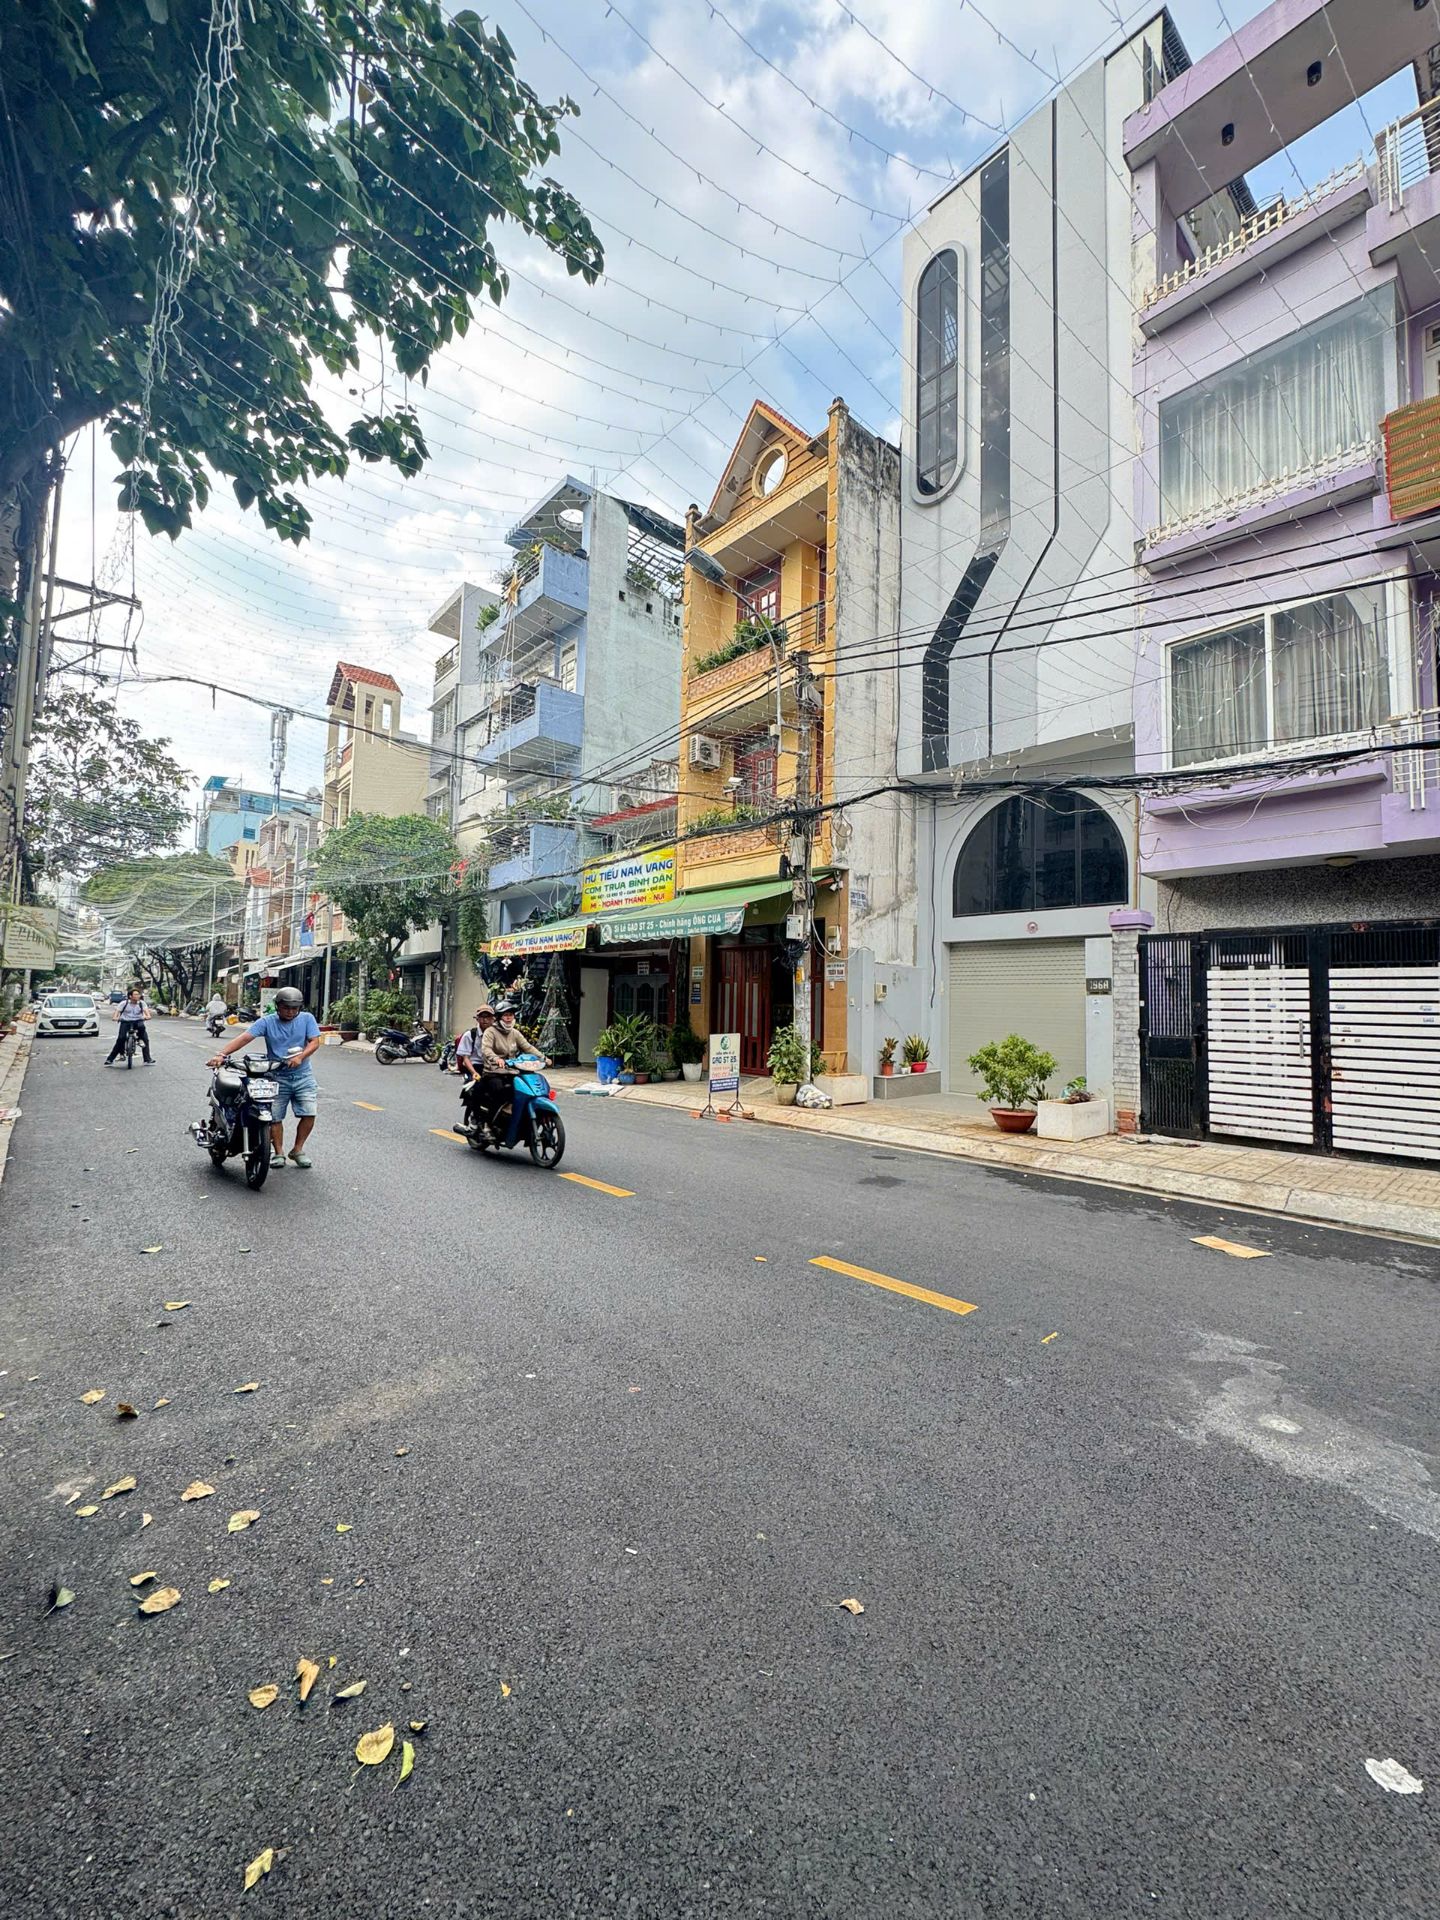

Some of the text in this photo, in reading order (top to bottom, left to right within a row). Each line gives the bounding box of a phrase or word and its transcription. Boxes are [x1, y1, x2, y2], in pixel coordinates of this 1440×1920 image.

[621, 865, 642, 878] NAM
[646, 859, 672, 872] VANG
[629, 876, 650, 888] BÌNH
[653, 873, 672, 883] DÂN
[639, 922, 646, 930] ST
[647, 921, 654, 929] 25
[659, 919, 675, 928] Chính
[707, 914, 721, 923] CUA
[540, 935, 554, 944] NAM
